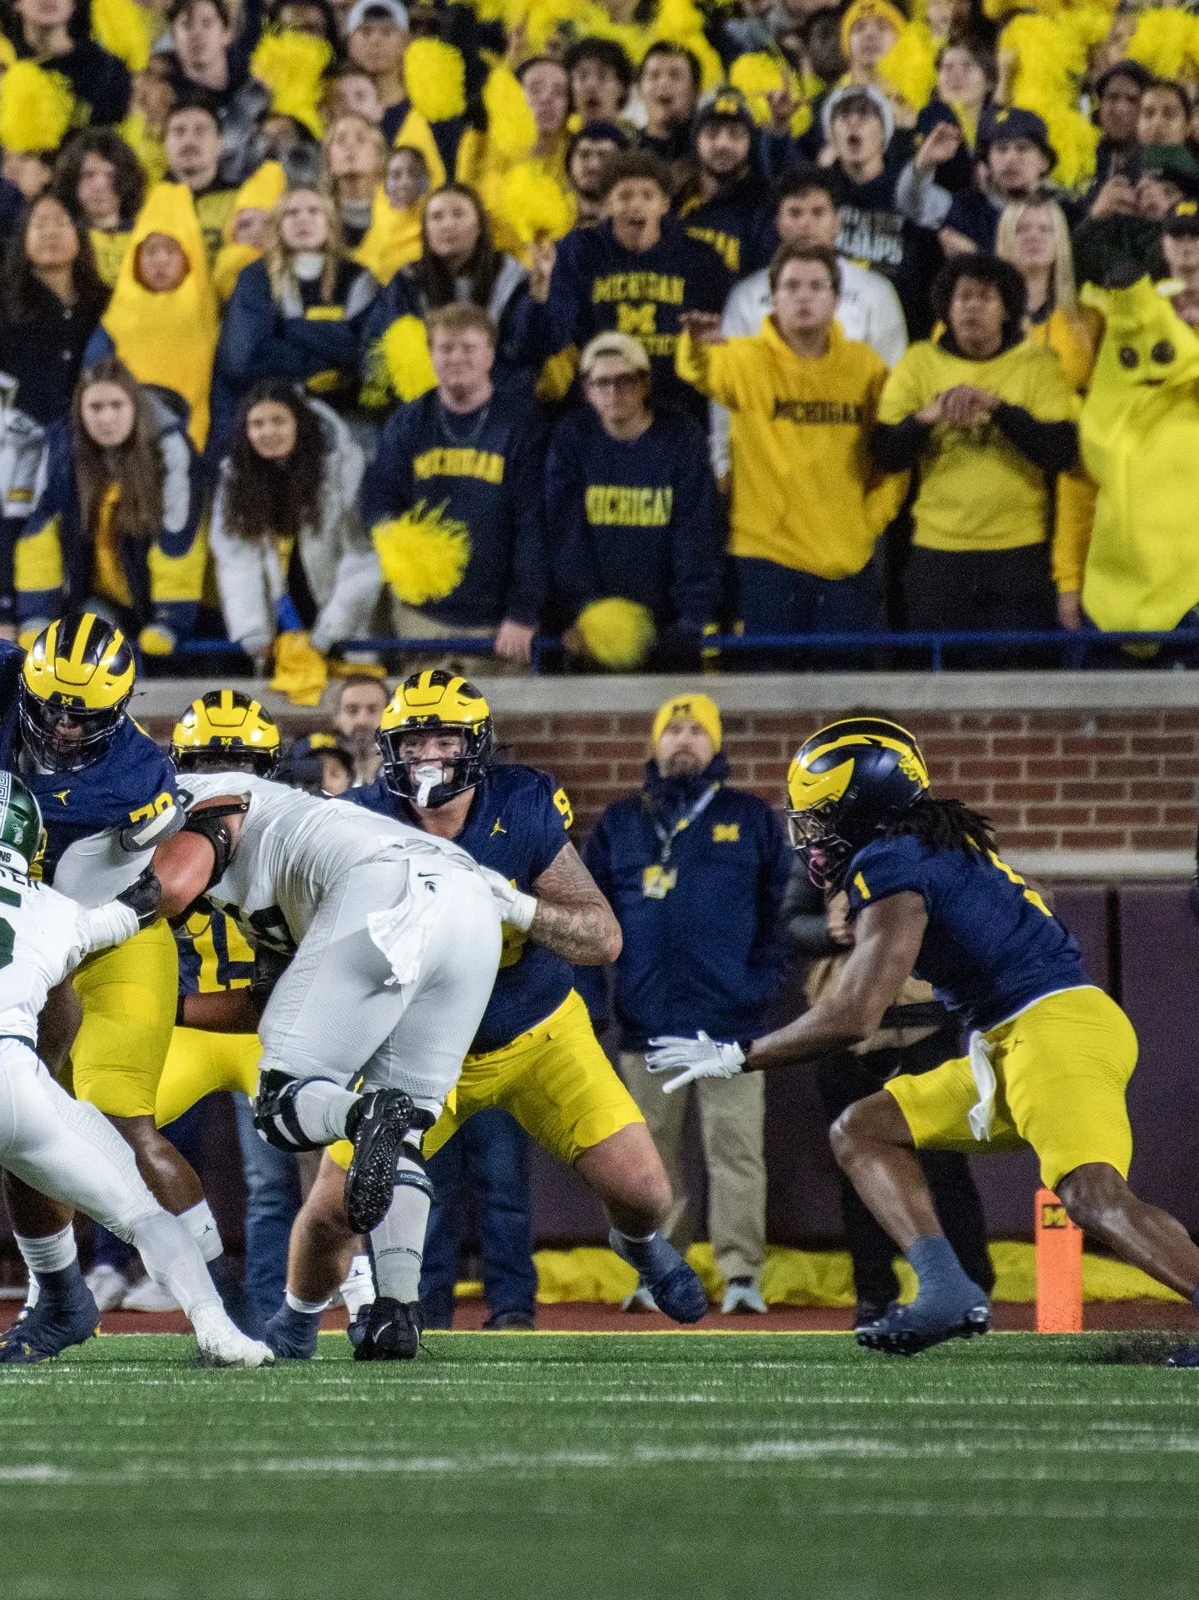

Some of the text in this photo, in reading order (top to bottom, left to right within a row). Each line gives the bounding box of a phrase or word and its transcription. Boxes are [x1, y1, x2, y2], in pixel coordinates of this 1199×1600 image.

[592, 271, 685, 305] MICHIGAN
[616, 301, 657, 334] M
[413, 447, 505, 485] MICHIGAN
[62, 695, 73, 705] M
[1043, 1206, 1066, 1227] M
